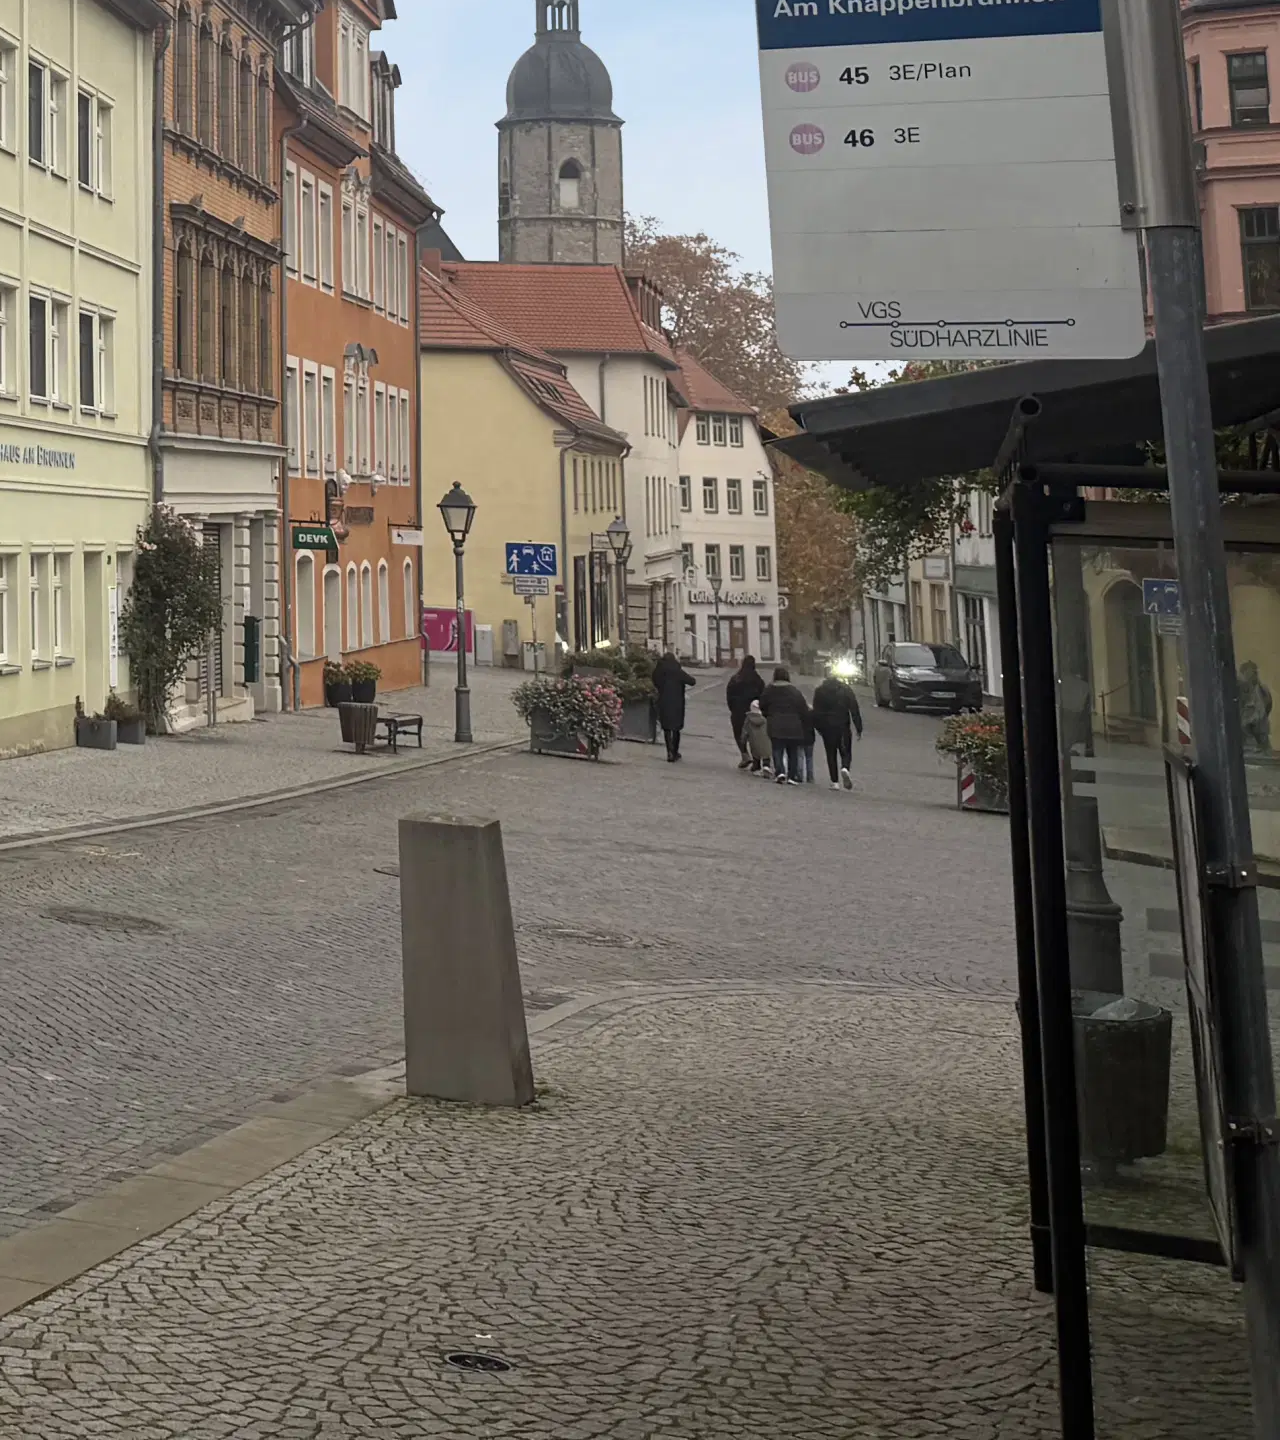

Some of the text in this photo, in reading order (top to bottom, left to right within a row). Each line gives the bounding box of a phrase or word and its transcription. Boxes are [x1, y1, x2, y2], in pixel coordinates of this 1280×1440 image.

[788, 62, 972, 85] BUS 45 3E/Plan
[791, 127, 921, 148] BUS 46 3E
[856, 300, 902, 319] VGS
[889, 328, 1049, 348] SÜDHARZLINIE
[298, 533, 329, 544] DEVK
